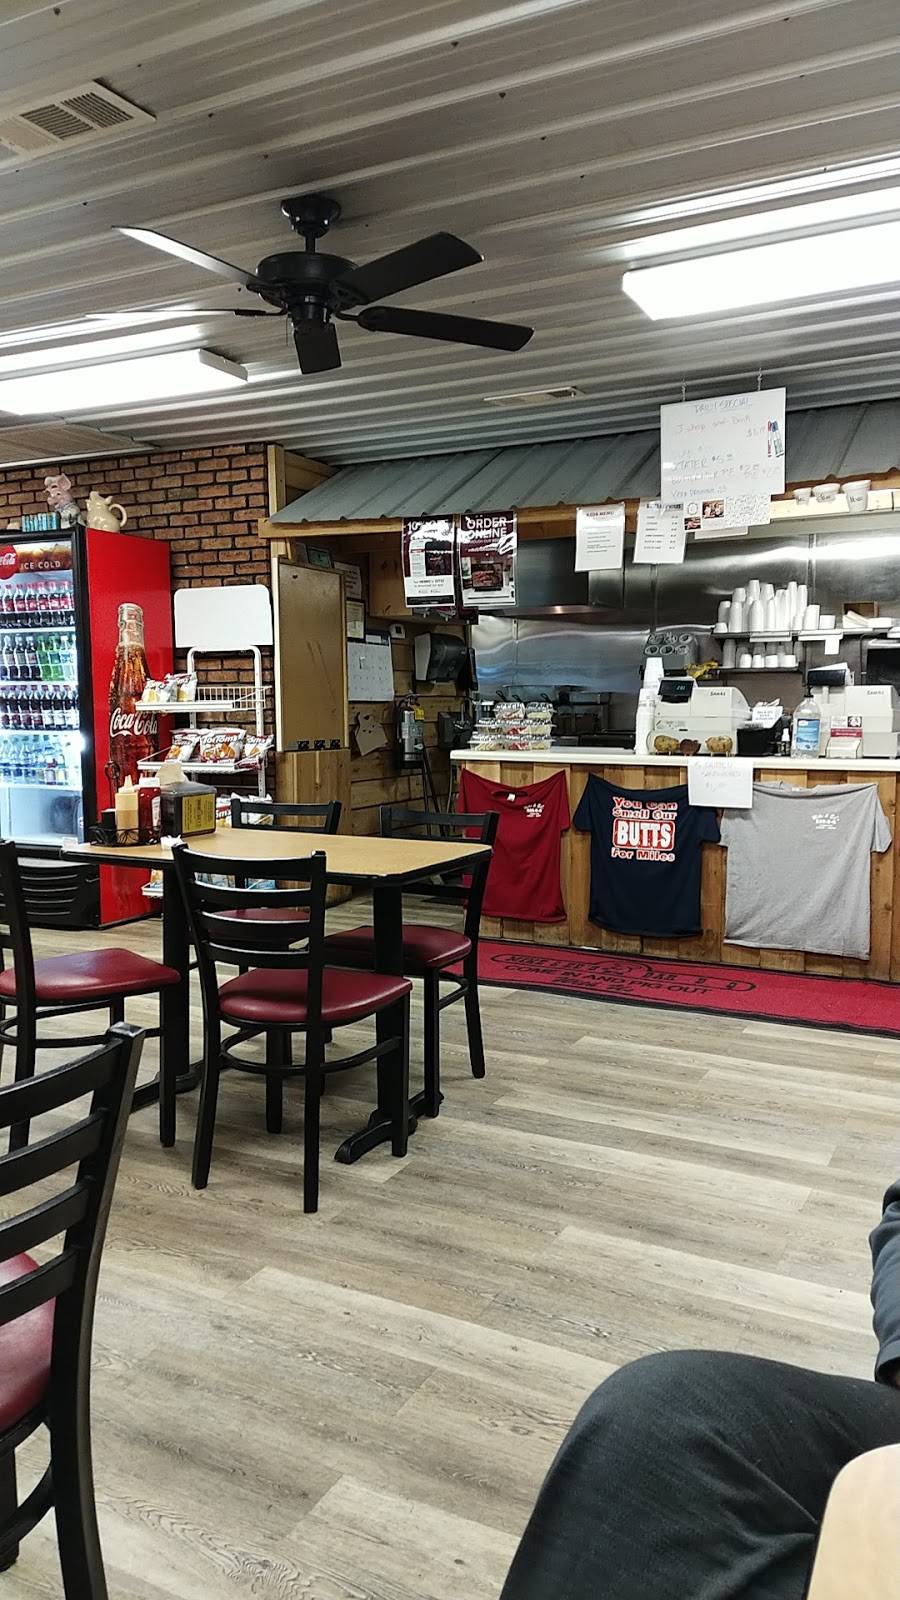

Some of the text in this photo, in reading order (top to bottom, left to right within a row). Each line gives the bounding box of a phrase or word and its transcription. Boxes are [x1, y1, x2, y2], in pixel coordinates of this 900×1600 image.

[466, 516, 507, 530] ORDER
[467, 527, 508, 540] ONLINE
[21, 560, 61, 570] ICE COLD
[612, 796, 678, 811] You Can
[612, 806, 678, 820] Smell Our
[617, 820, 671, 848] BUTTS
[611, 846, 675, 861] For Miles
[504, 964, 556, 974] COME
[583, 973, 625, 984] AND
[628, 979, 663, 989] PIG
[667, 984, 713, 995] OUT
